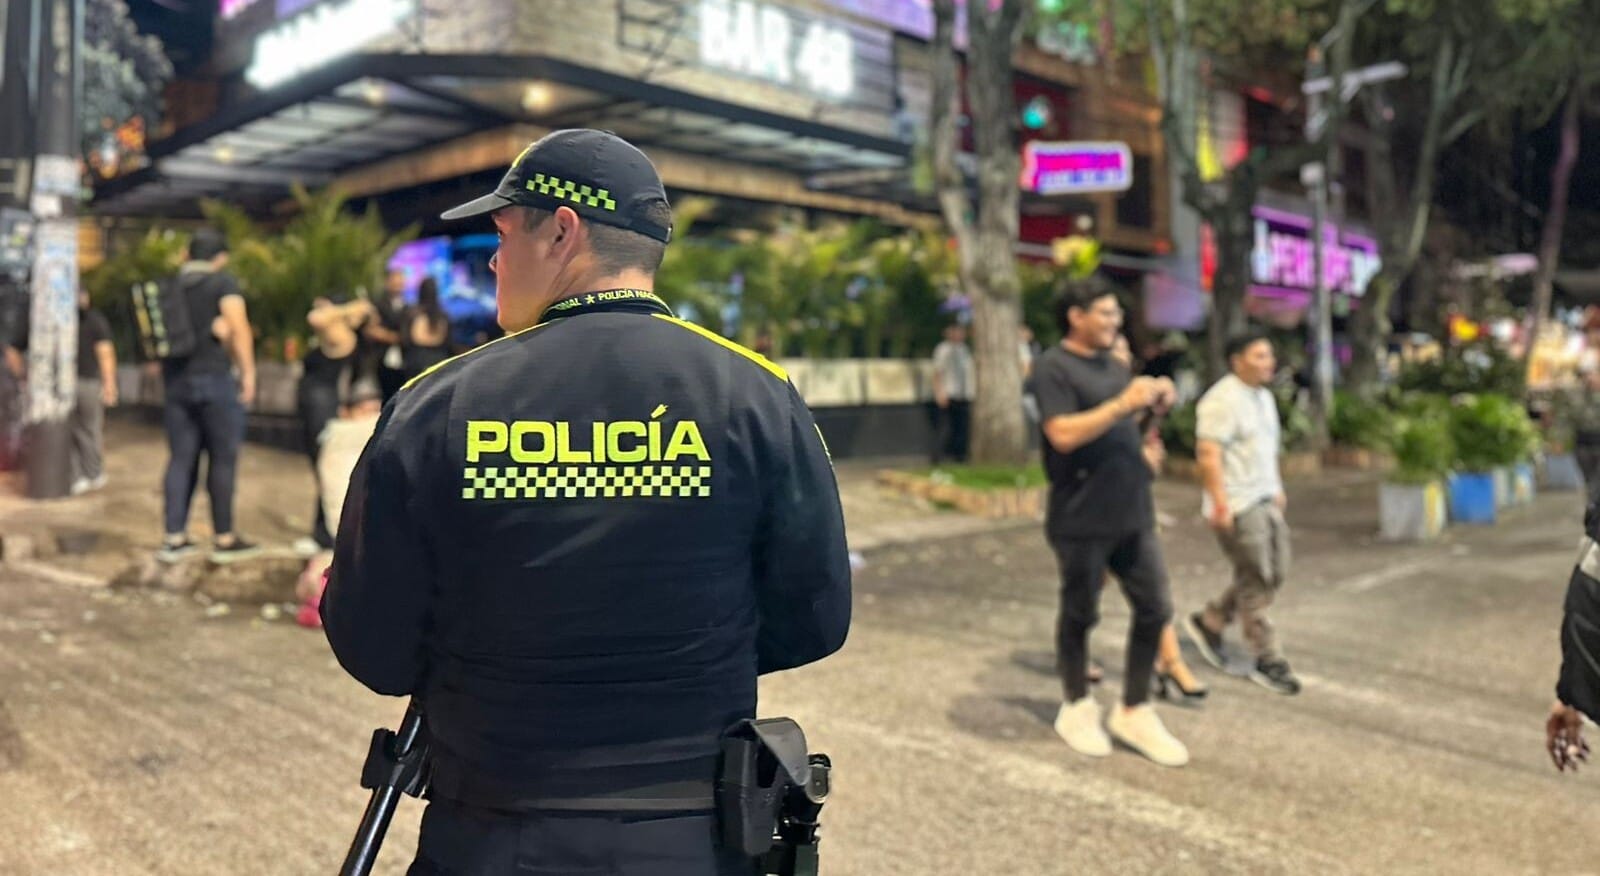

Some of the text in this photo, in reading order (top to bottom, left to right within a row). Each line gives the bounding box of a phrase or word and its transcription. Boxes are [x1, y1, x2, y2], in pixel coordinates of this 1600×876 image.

[700, 0, 791, 83] BAR
[597, 288, 635, 301] POLICÍA
[466, 403, 712, 463] POLICÍA
